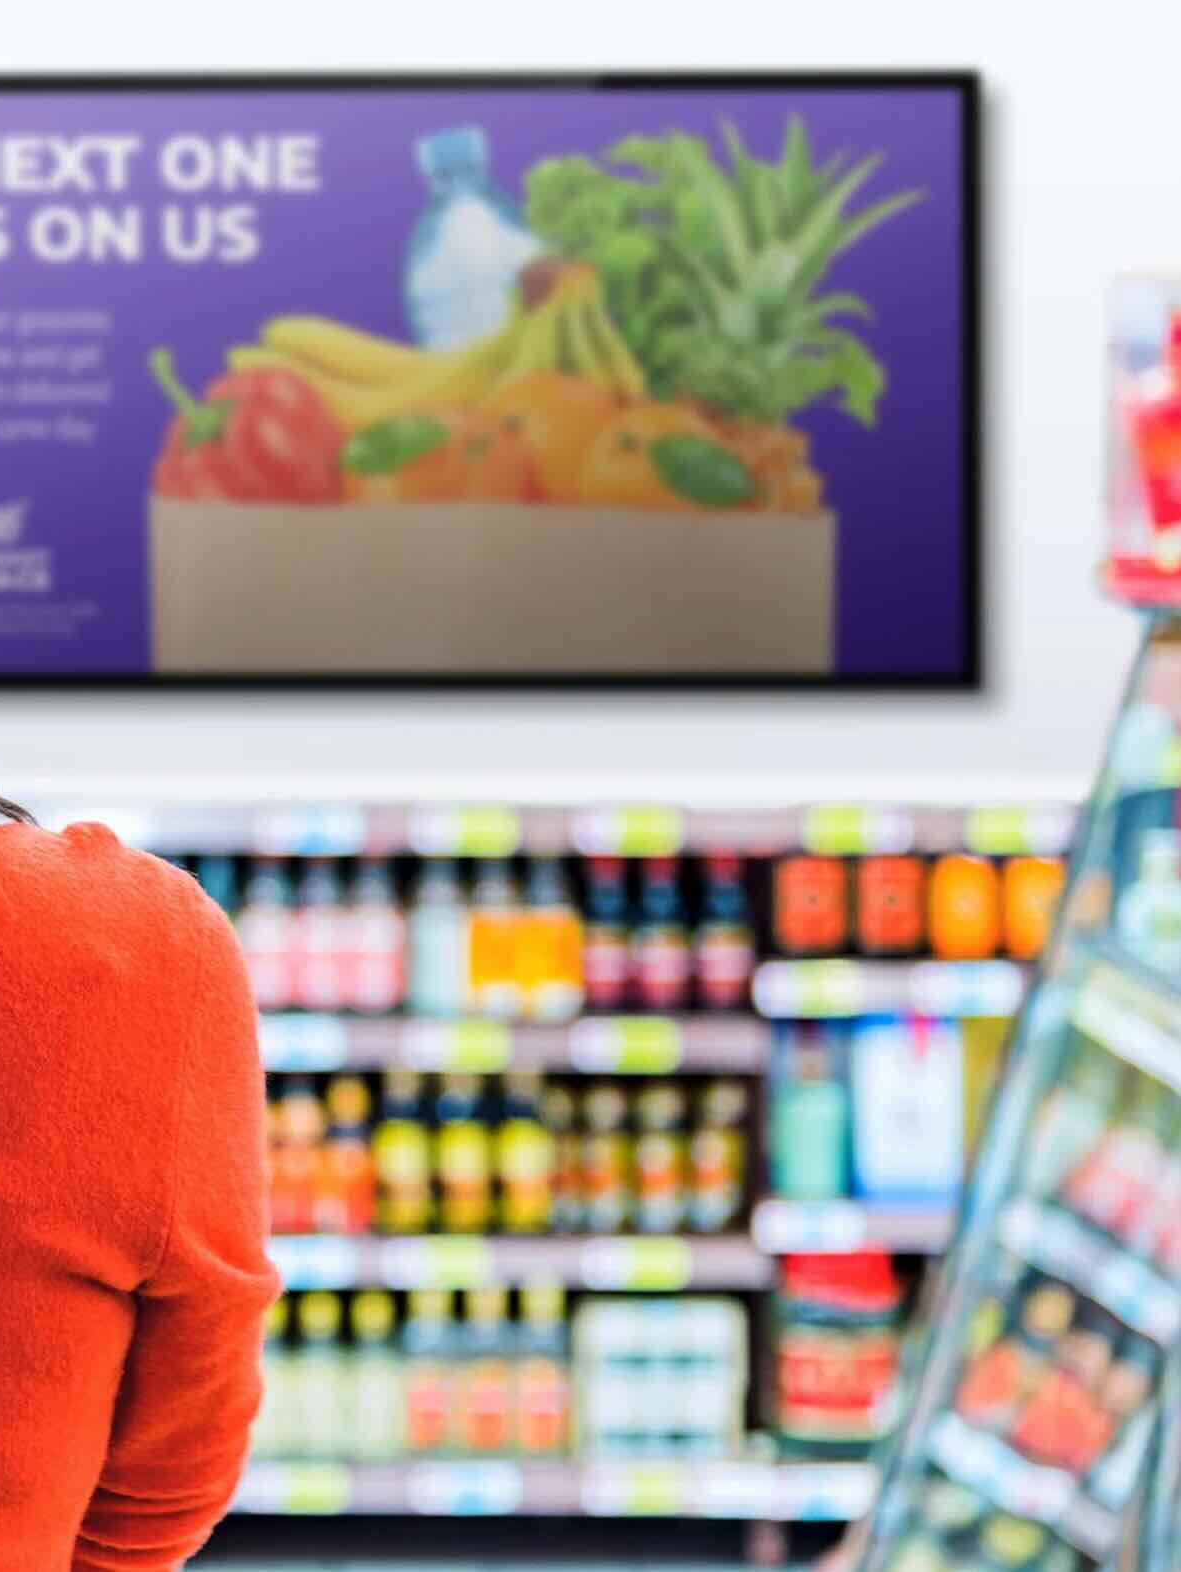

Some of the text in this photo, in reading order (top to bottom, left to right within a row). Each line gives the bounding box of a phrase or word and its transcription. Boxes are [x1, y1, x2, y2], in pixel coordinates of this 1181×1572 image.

[160, 135, 320, 191] ONE
[29, 206, 140, 262] ON
[163, 206, 260, 262] US
